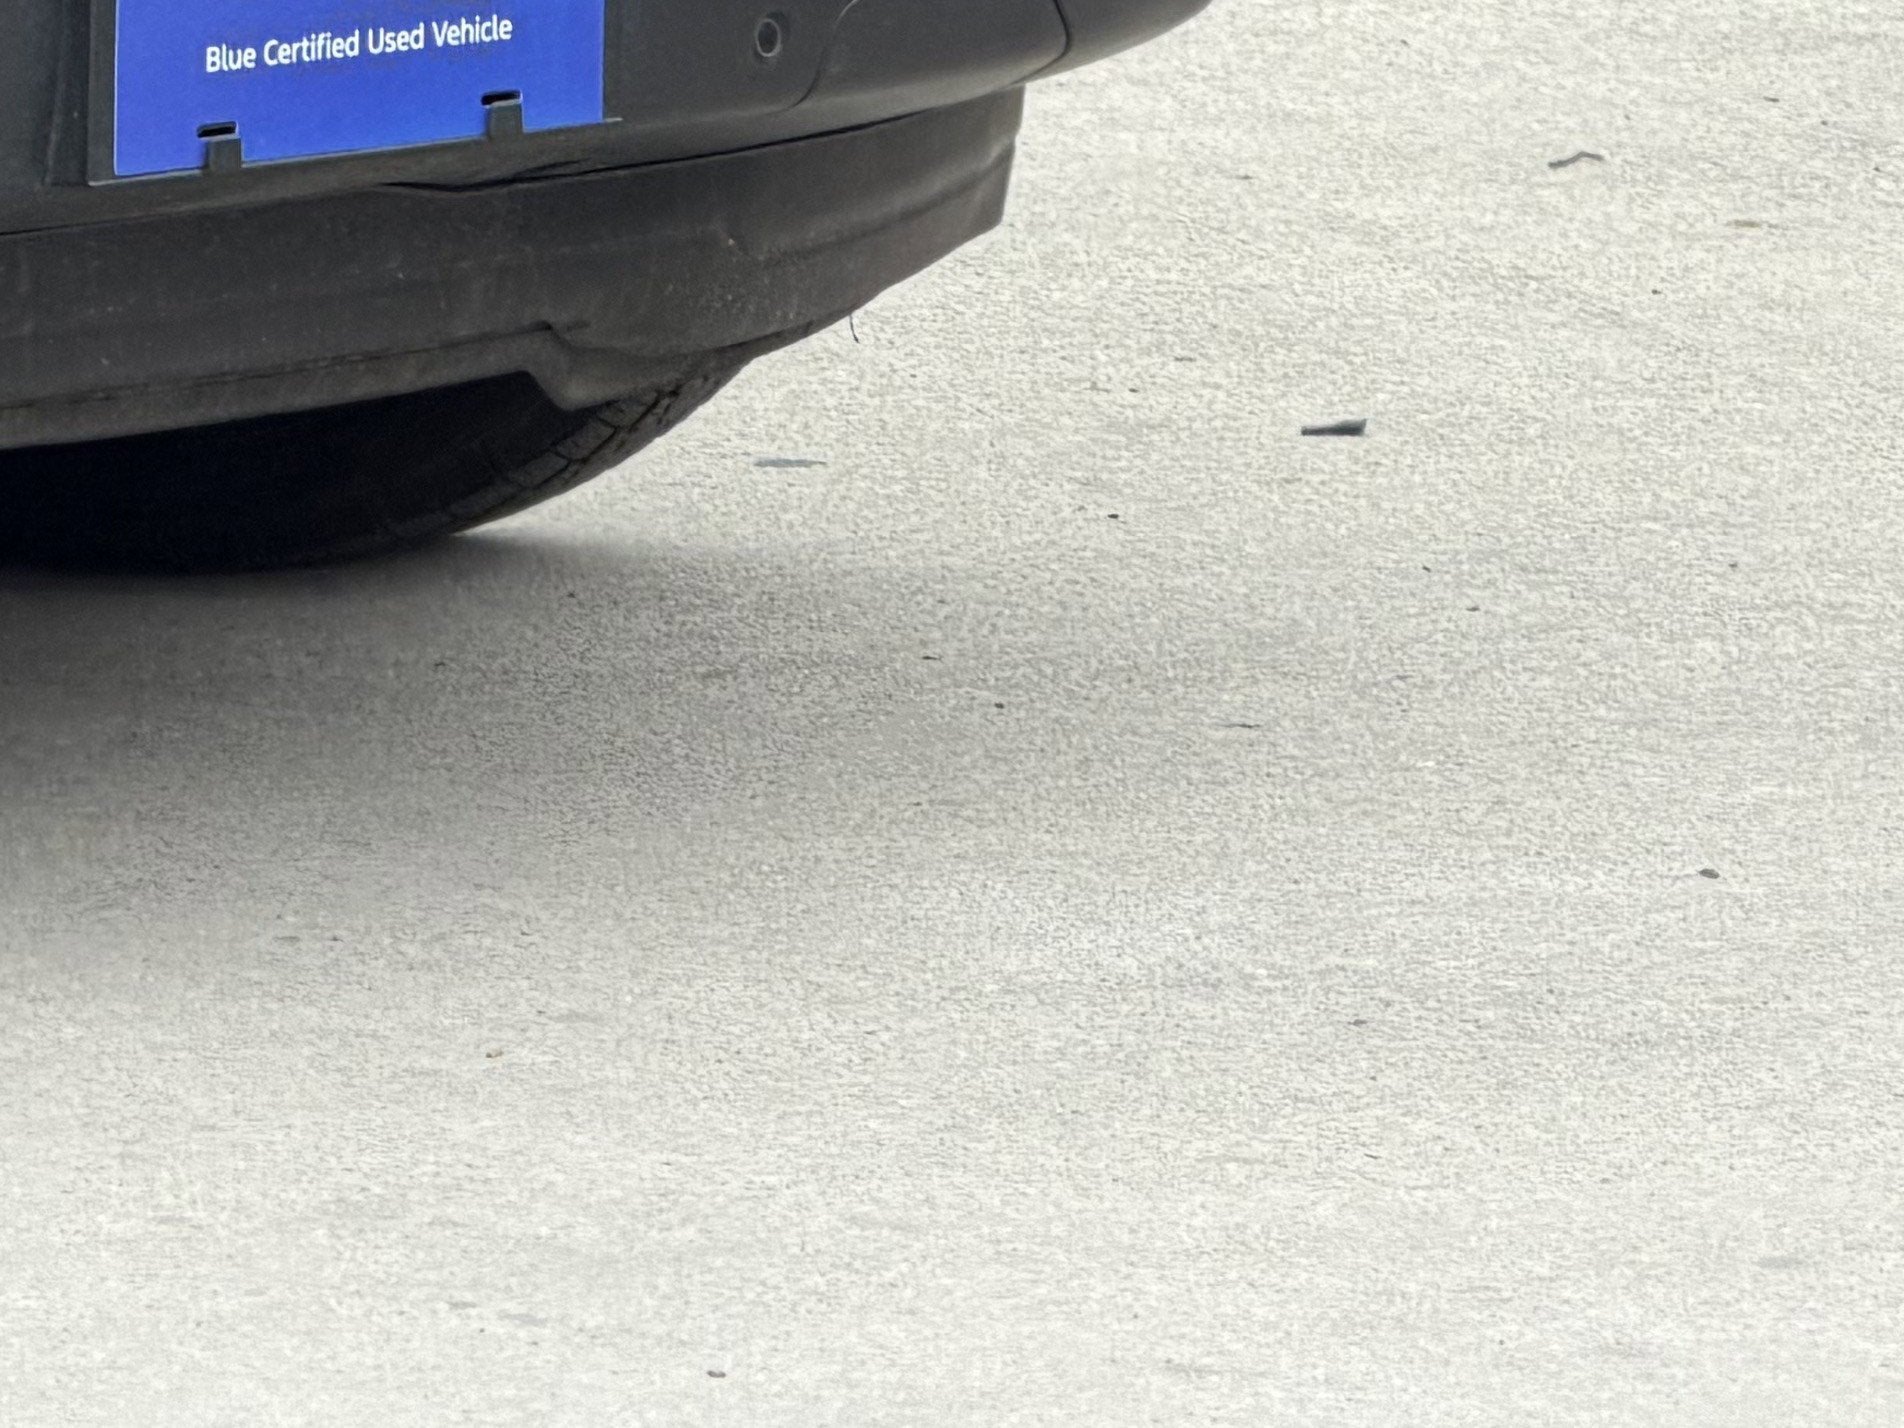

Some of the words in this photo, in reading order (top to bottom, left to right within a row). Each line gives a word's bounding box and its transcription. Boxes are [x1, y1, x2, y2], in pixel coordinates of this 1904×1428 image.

[205, 45, 257, 73] Blue
[263, 29, 360, 66] Certified
[367, 23, 425, 53] Used
[432, 14, 513, 47] Vehicle
